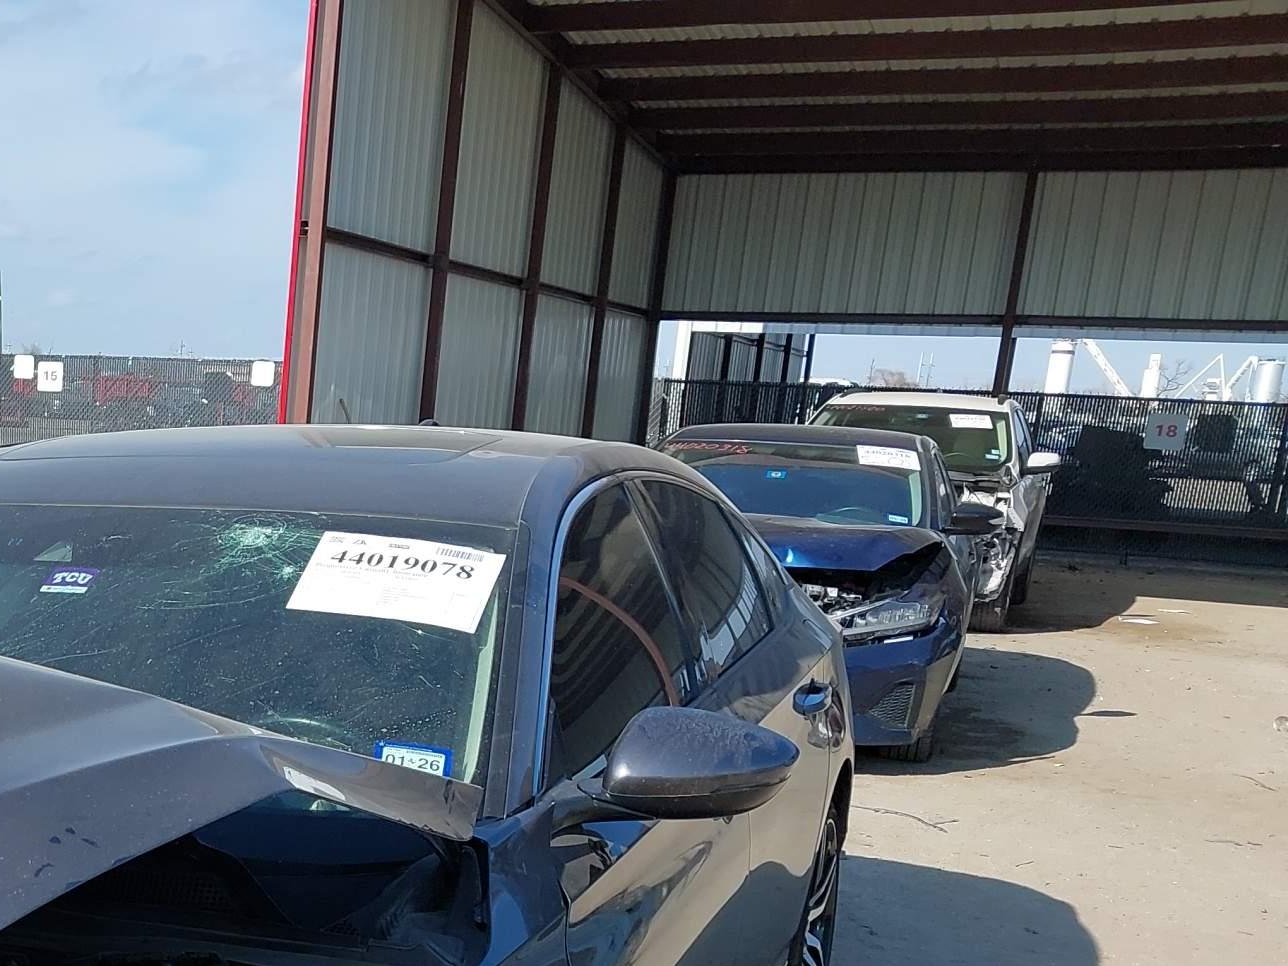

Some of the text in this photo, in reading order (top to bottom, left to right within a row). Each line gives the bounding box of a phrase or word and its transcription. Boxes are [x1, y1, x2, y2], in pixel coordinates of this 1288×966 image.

[43, 370, 58, 381] 15
[1156, 424, 1178, 437] 18
[330, 550, 475, 579] 44019078
[52, 571, 94, 585] TCU
